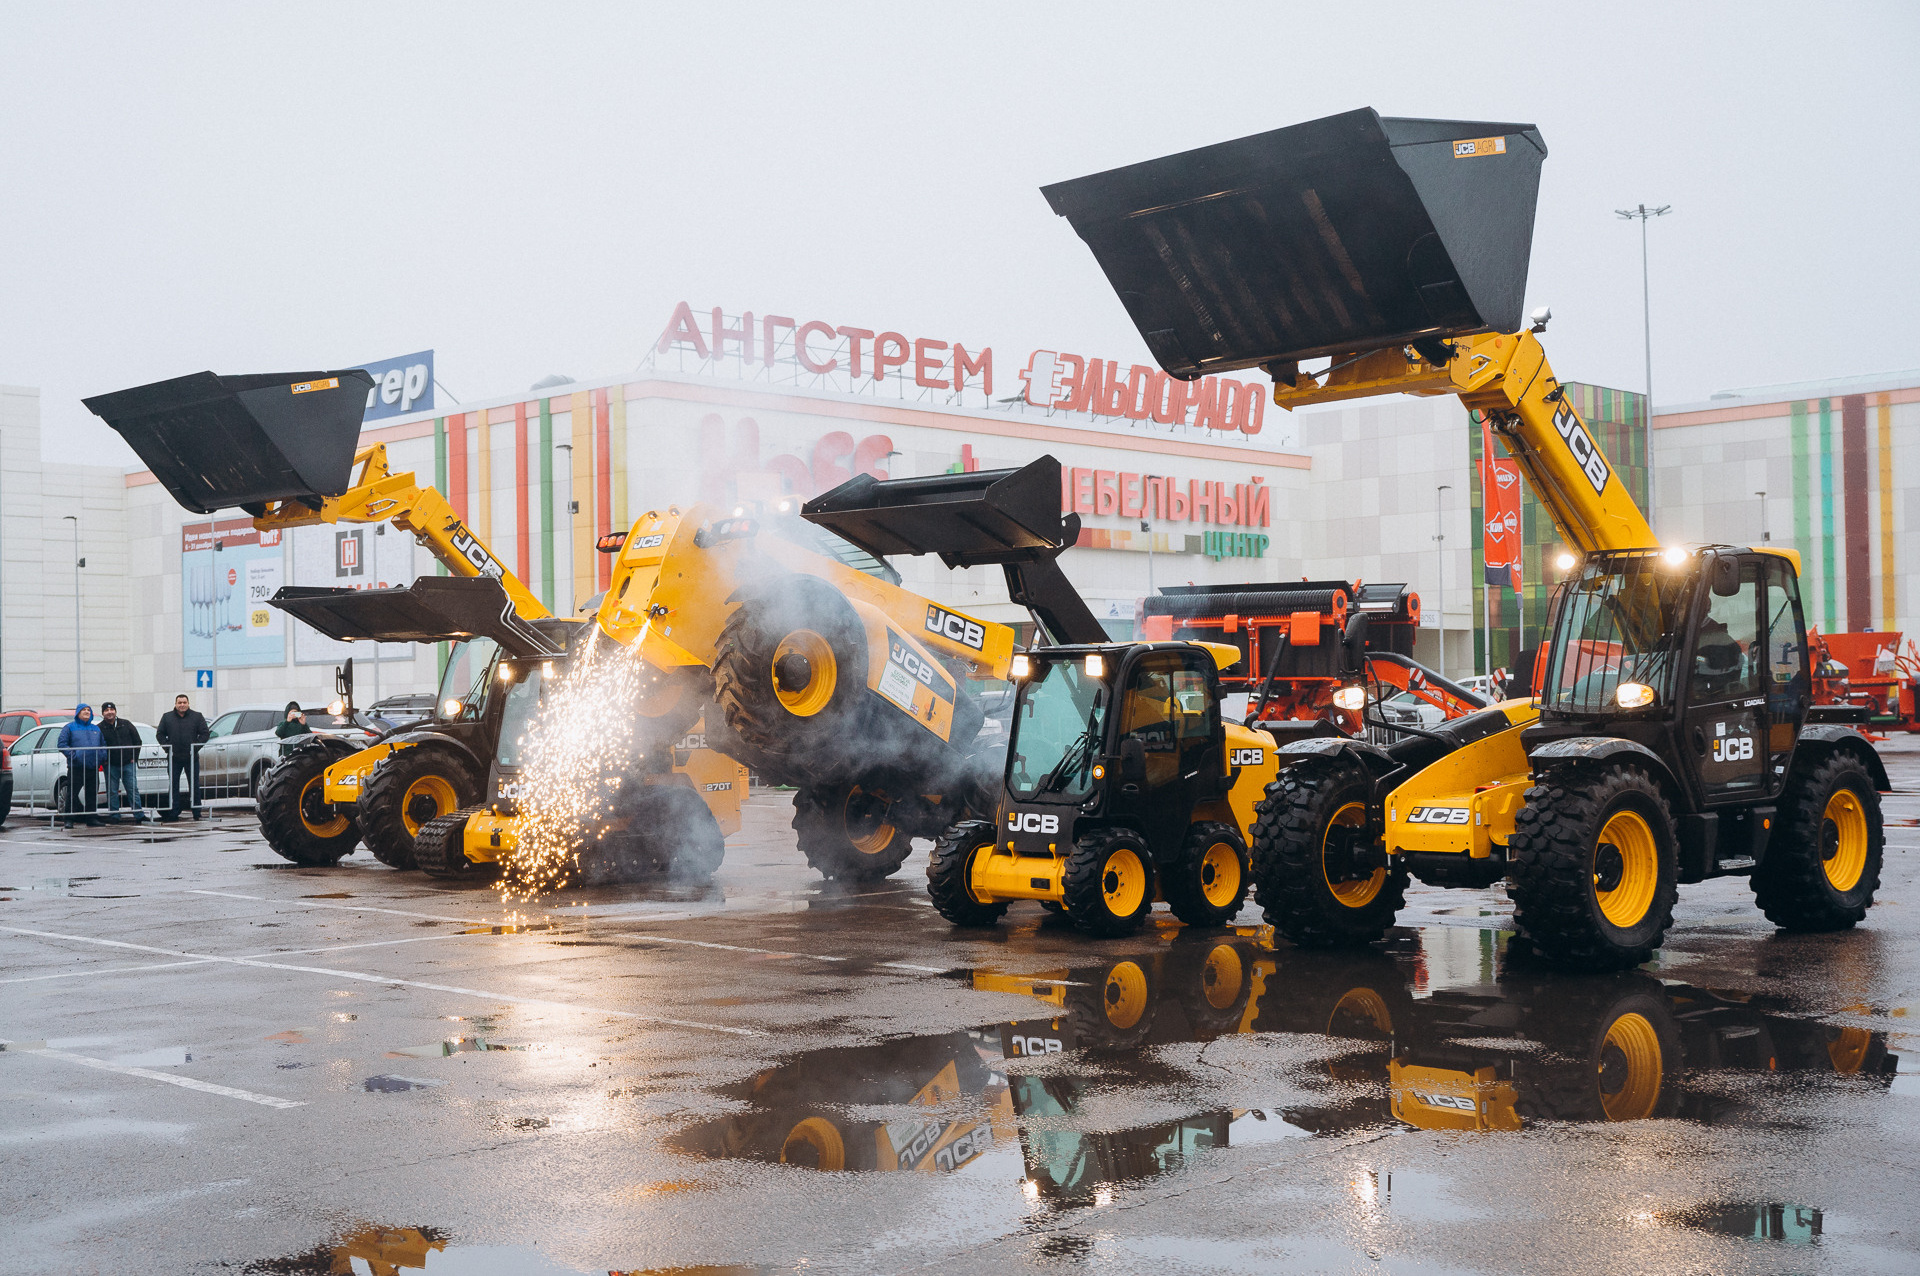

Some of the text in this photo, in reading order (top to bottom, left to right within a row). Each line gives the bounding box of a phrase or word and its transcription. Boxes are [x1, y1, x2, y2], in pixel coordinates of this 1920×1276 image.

[1455, 142, 1475, 155] JCB
[658, 300, 993, 396] АНГСТРЕМ
[293, 383, 311, 393] JCB
[1554, 411, 1608, 492] JCB
[633, 534, 664, 549] JCB
[1204, 531, 1270, 562] ЦЕНТР
[251, 586, 266, 598] 790
[926, 610, 984, 649] JCB
[892, 647, 934, 685] JCB
[1230, 749, 1263, 765] JCB
[1713, 737, 1754, 763] JCB
[706, 782, 731, 792] 270T
[1008, 812, 1059, 834] JCB
[1408, 807, 1470, 824] JCB
